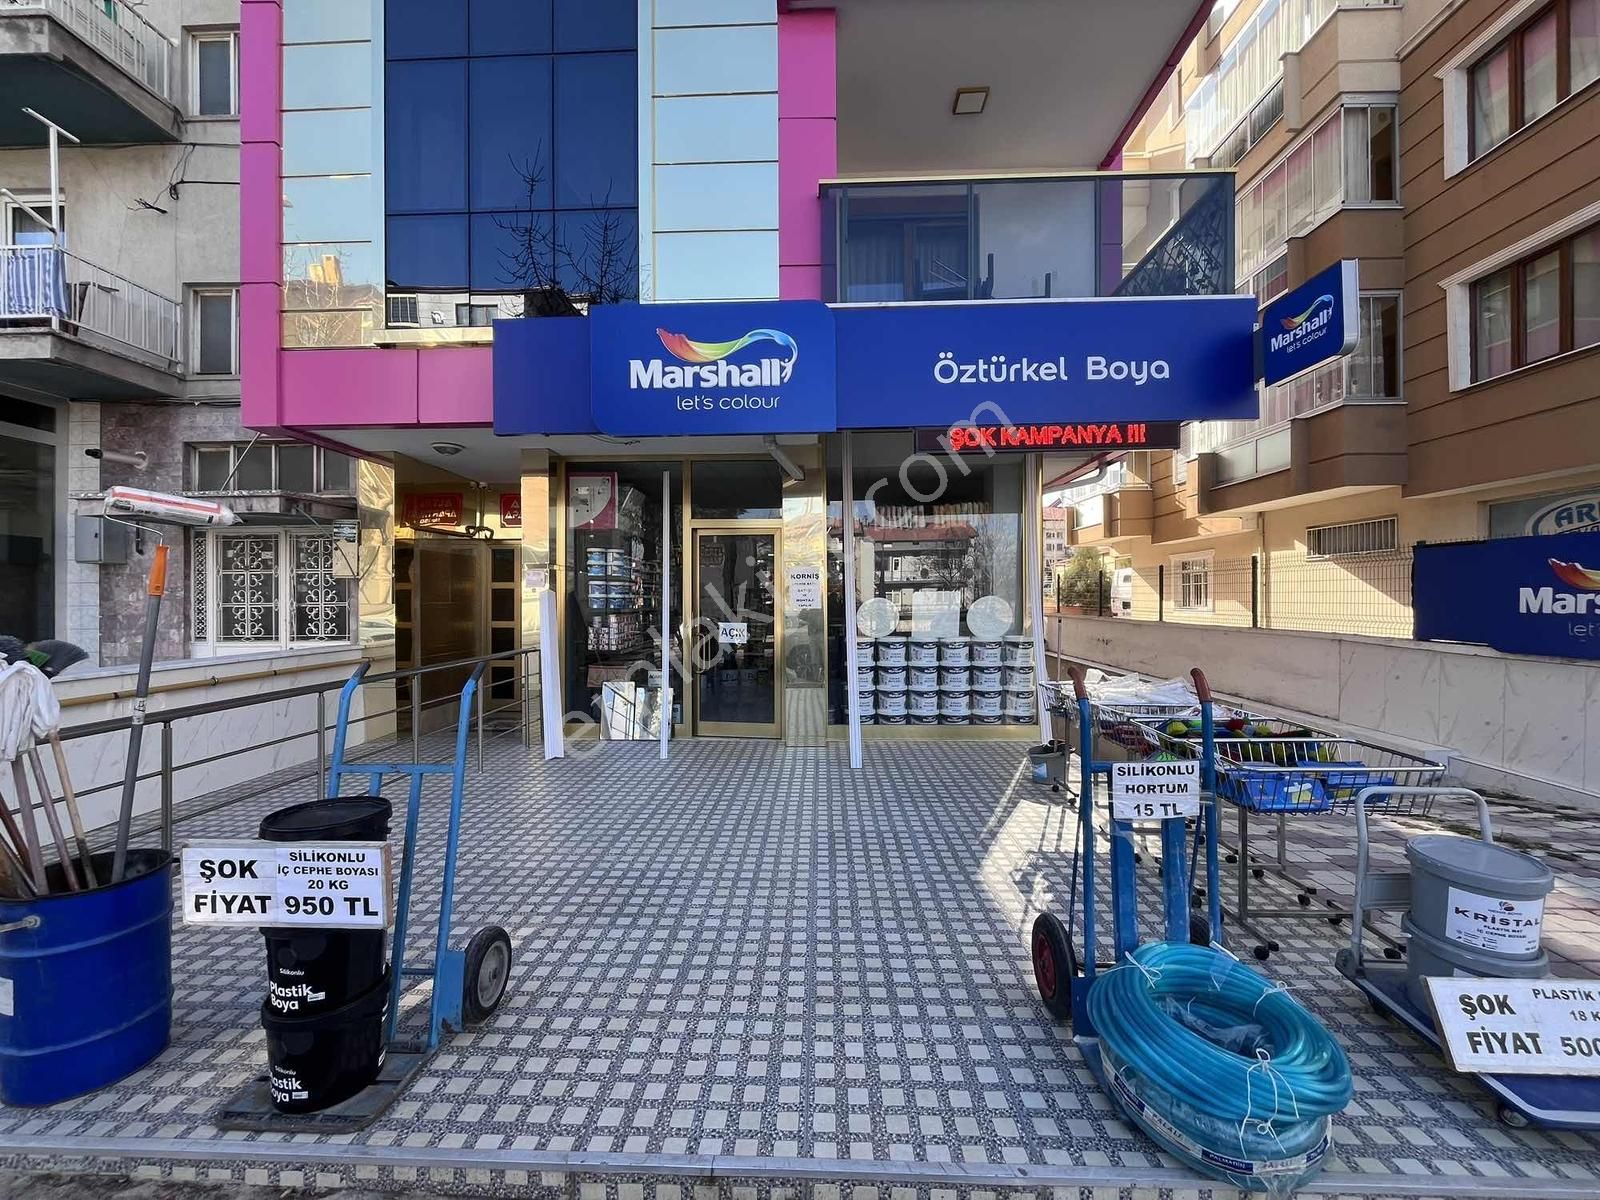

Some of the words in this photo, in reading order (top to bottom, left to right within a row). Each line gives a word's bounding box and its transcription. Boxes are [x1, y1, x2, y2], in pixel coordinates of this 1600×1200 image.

[1270, 309, 1328, 352] Marshall
[1302, 327, 1327, 345] colour
[629, 358, 781, 389] Marshall
[934, 351, 1068, 384] Öztürkel
[1086, 356, 1170, 385] Boya
[676, 394, 714, 411] let's
[719, 394, 781, 410] colour
[950, 427, 996, 450] ŞOK
[1001, 425, 1122, 446] KAMPANYA
[1117, 763, 1195, 776] SİLİKONLU
[1125, 783, 1188, 794] HORTUM
[1133, 803, 1154, 817] 15
[1160, 803, 1183, 817] TL
[289, 849, 366, 863] SİLİKONLU
[199, 859, 258, 884] ŞOK
[277, 864, 290, 876] İÇ
[293, 866, 332, 876] CEPHE
[336, 866, 379, 877] BOYASI
[308, 879, 324, 890] 20
[328, 880, 349, 890] KG
[194, 889, 272, 914] FİYAT
[284, 896, 334, 915] 950
[343, 897, 379, 917] TL
[1454, 906, 1540, 926] KRİSTAL
[270, 980, 314, 997] Plastik
[1532, 987, 1596, 1001] PLASTİK
[271, 993, 299, 1013] Boya
[1459, 993, 1517, 1020] ŞOK
[1569, 1009, 1588, 1022] 18
[1466, 1026, 1543, 1055] FİYAT
